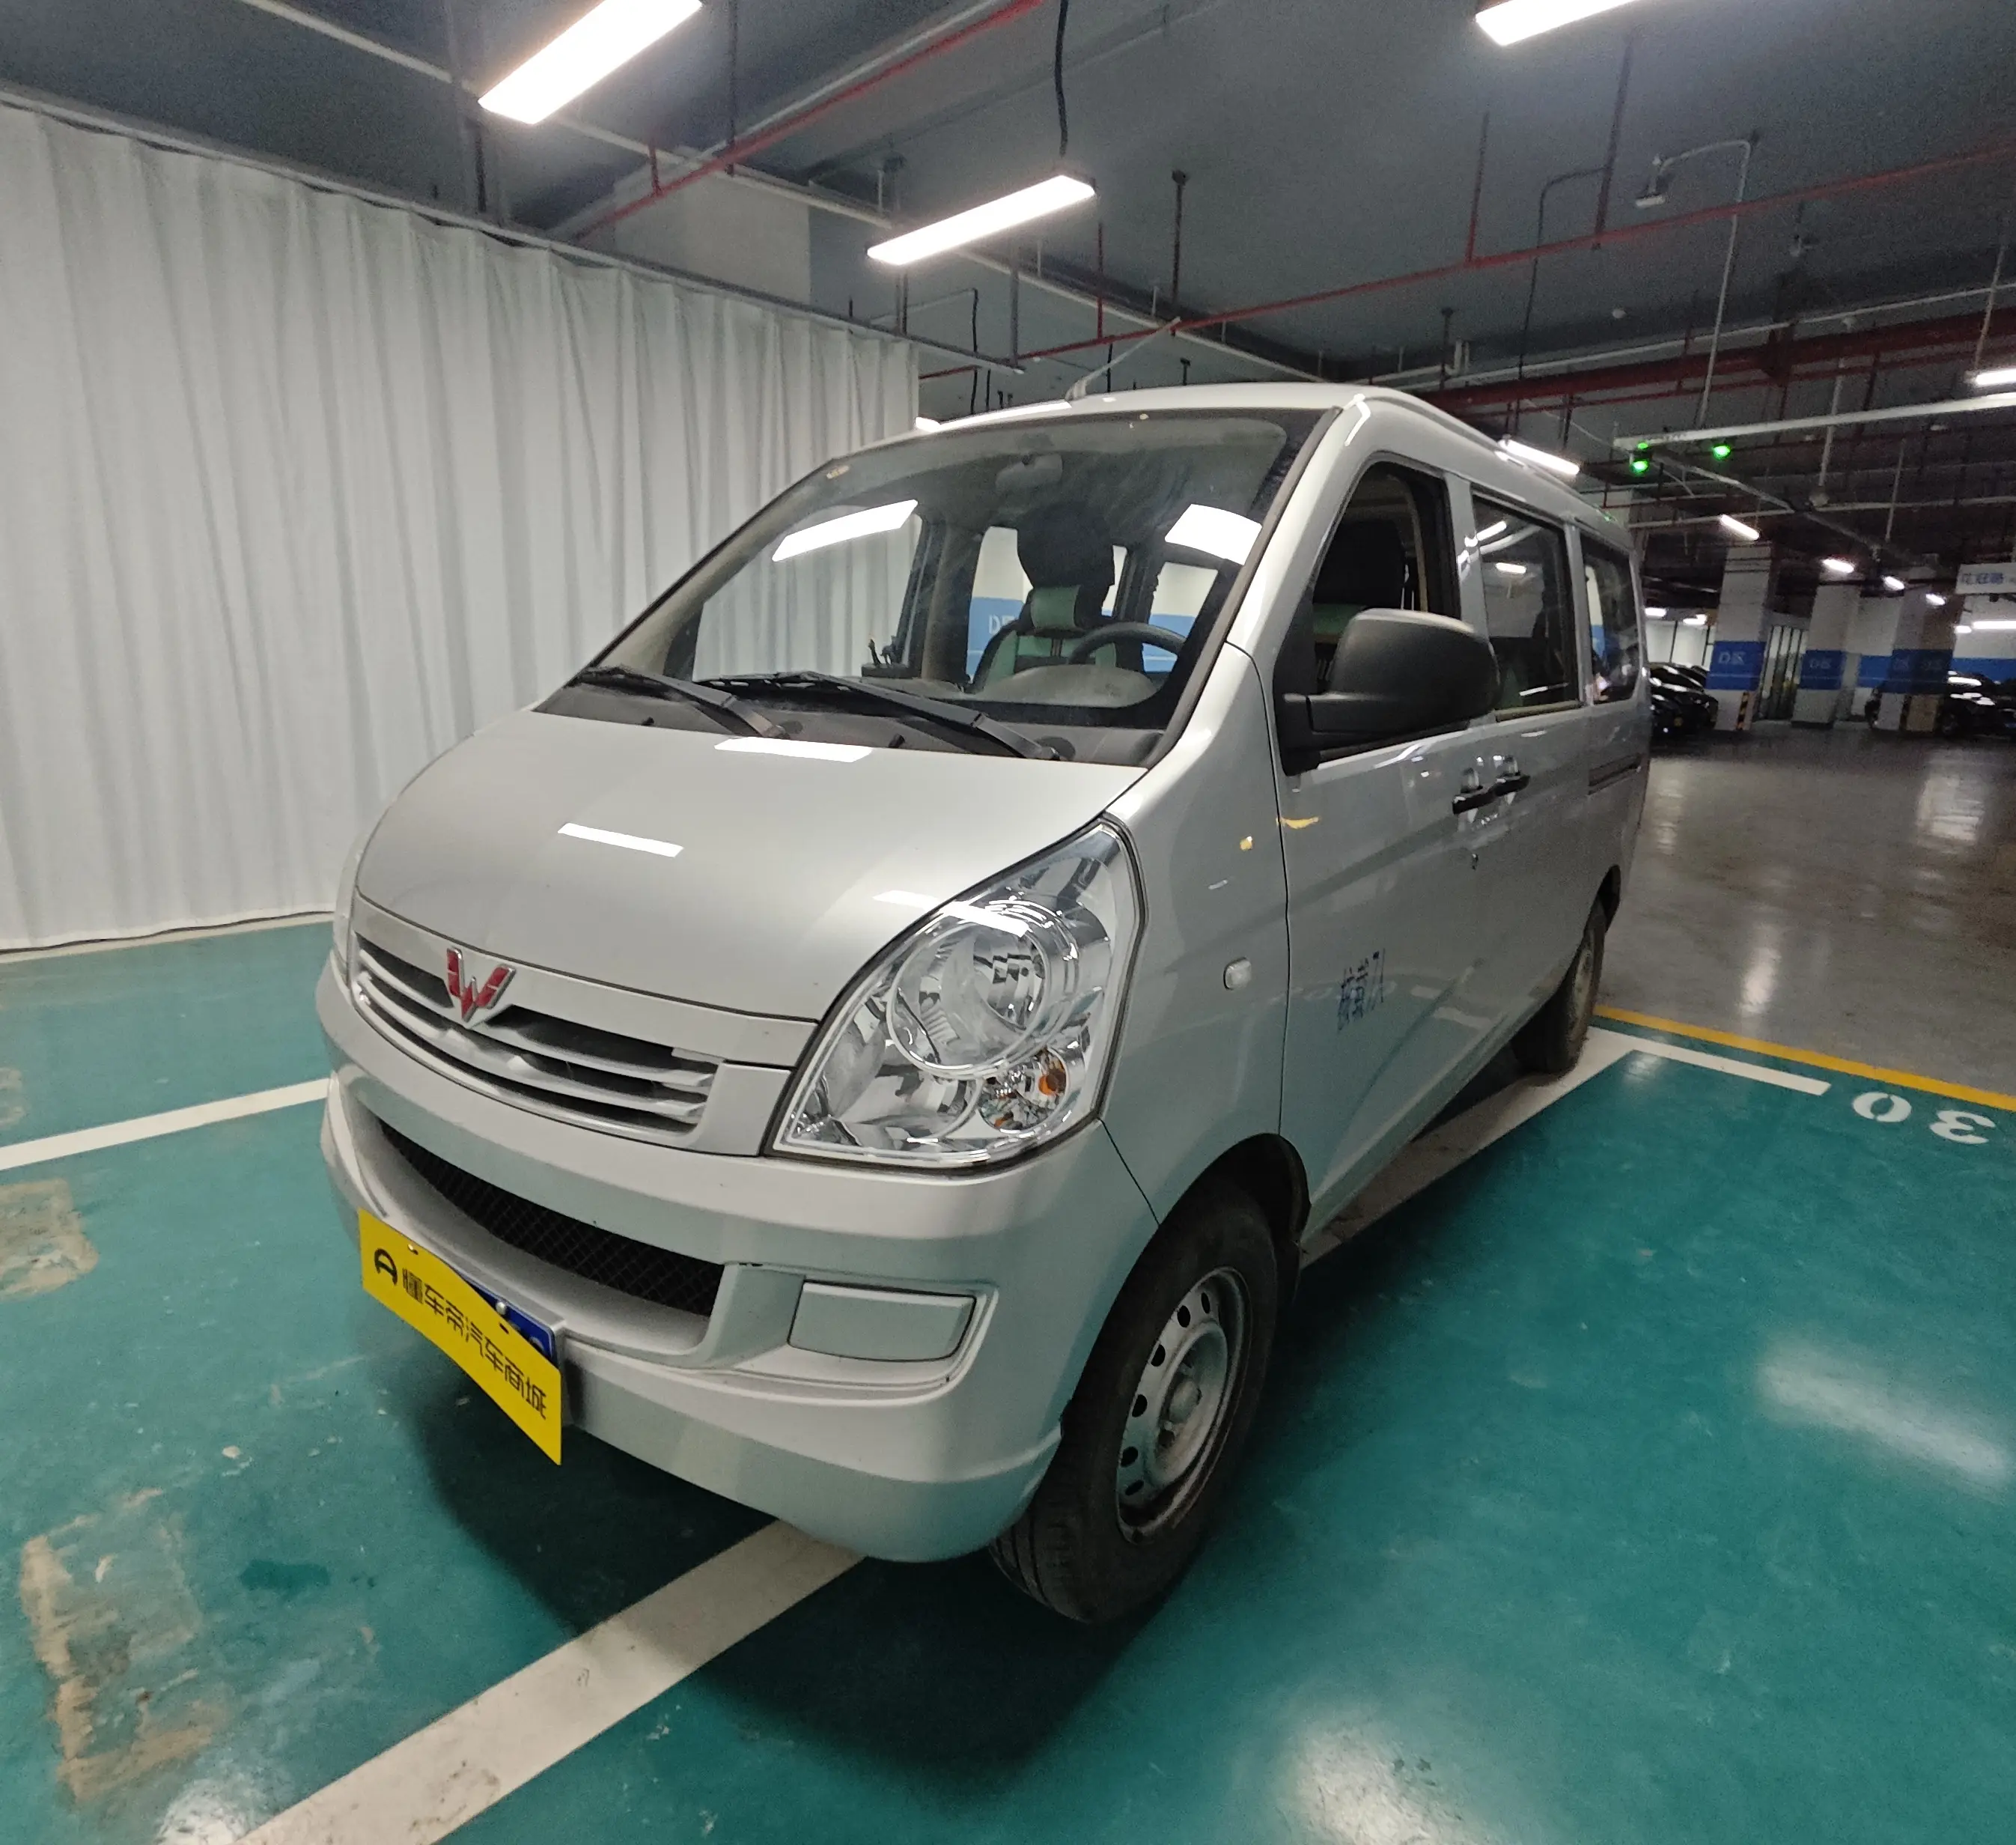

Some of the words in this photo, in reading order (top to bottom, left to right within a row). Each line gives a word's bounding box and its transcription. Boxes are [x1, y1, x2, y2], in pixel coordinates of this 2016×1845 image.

[402, 1268, 546, 1420] 懂车帝汽车商城
